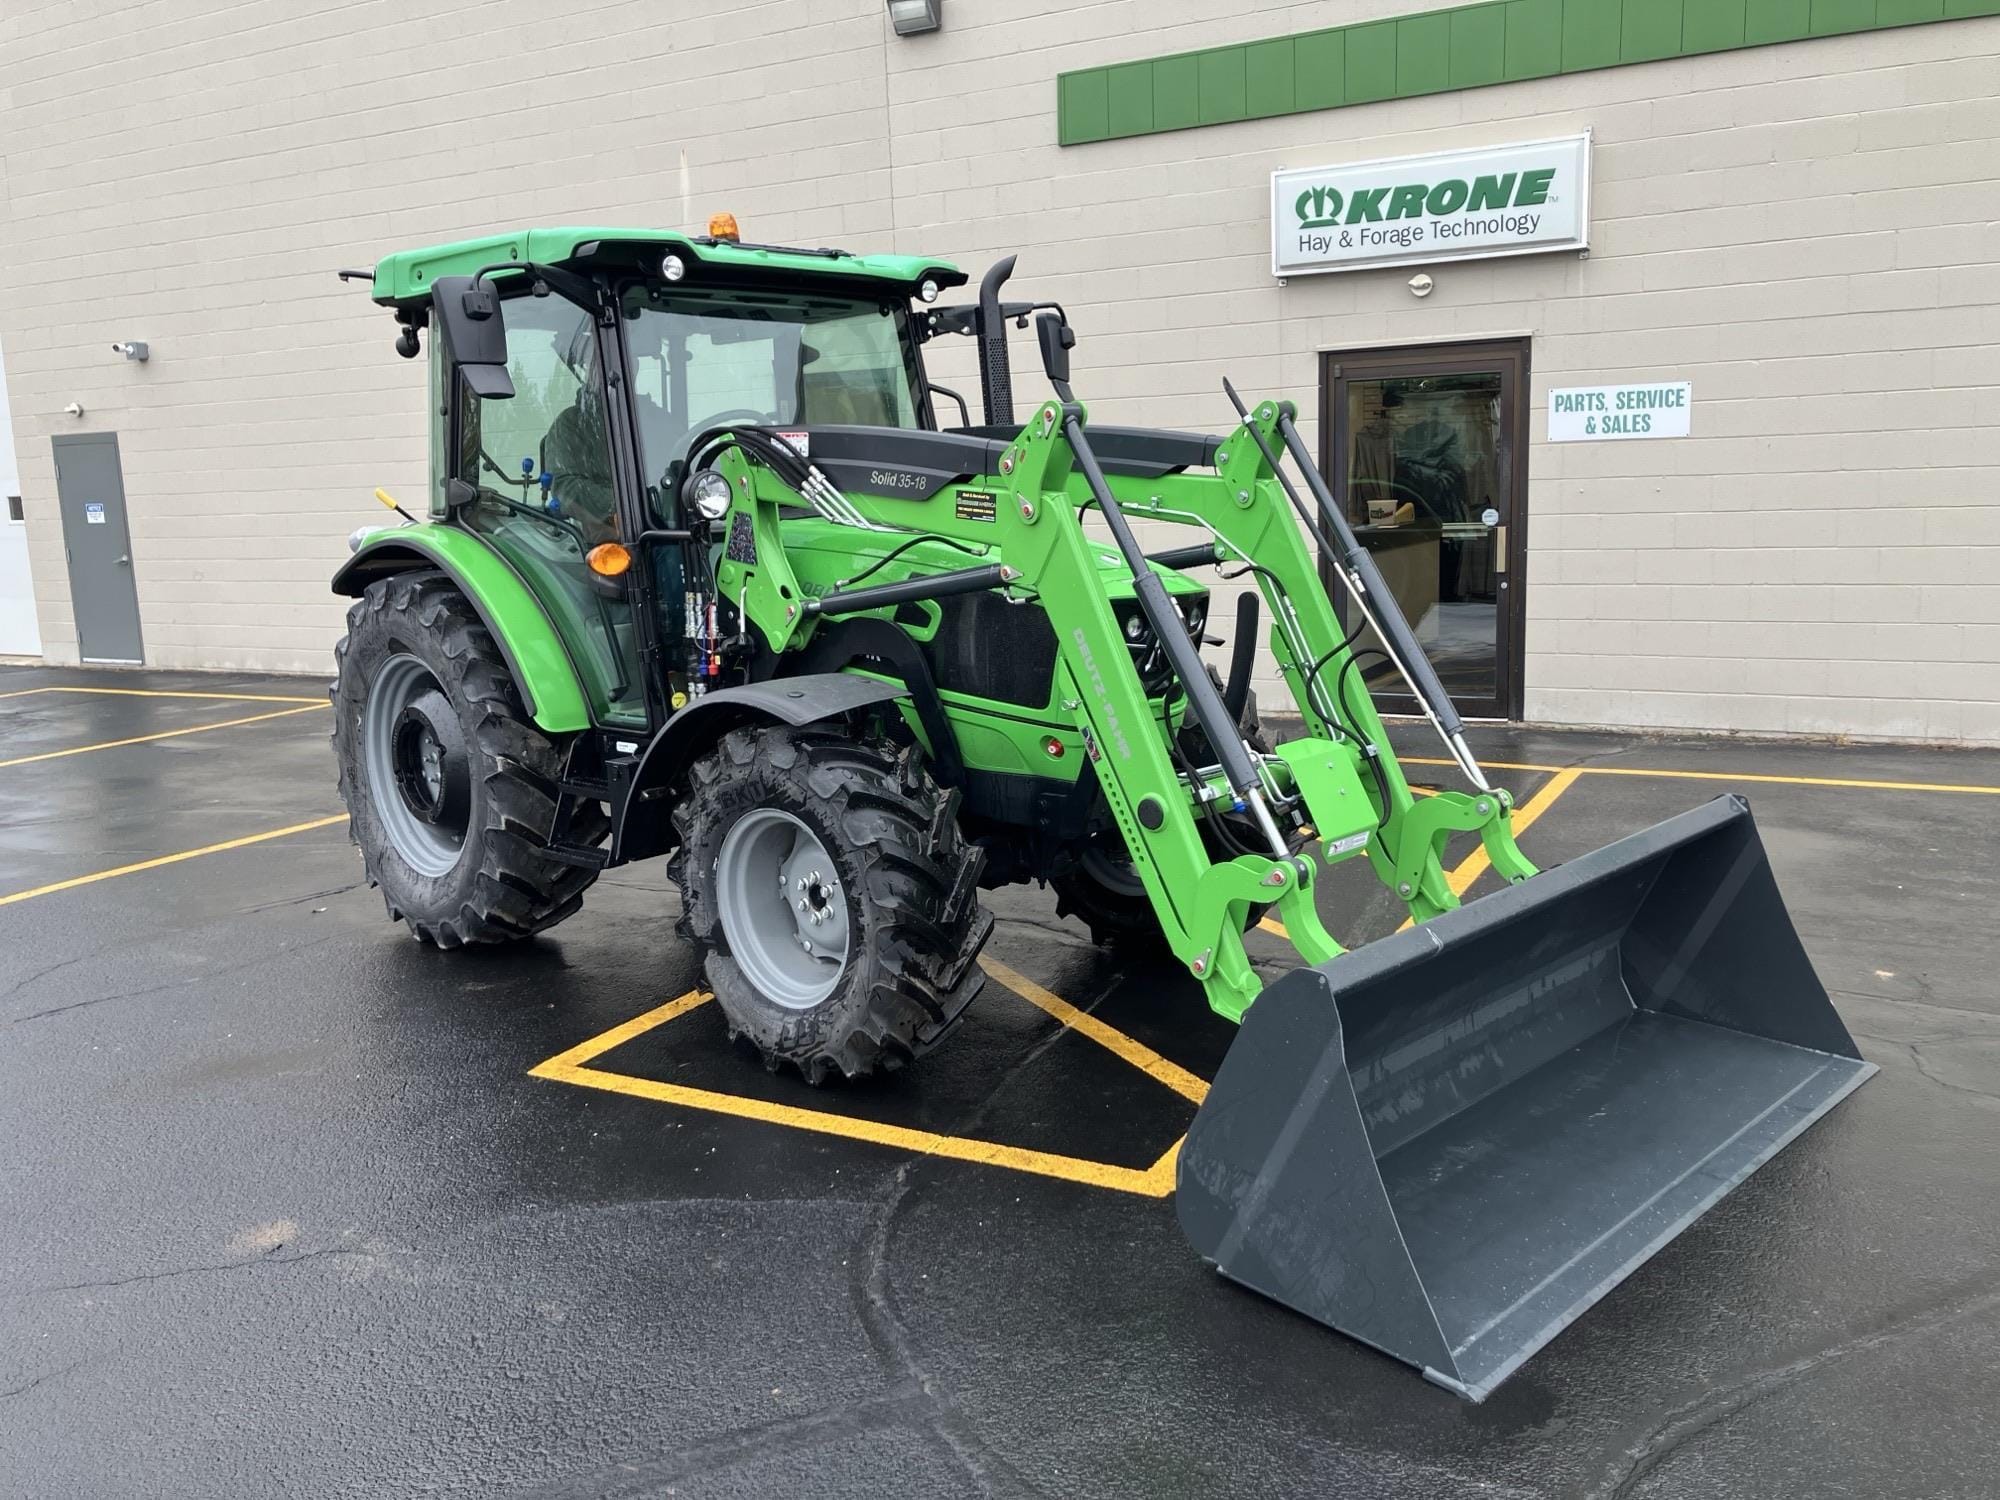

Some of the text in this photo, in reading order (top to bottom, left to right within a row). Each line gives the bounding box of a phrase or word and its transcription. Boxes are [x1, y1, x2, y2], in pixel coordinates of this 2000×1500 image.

[1345, 168, 1556, 224] KRONE
[1299, 214, 1541, 254] Hay & Forage Technology
[1554, 388, 1685, 413] PARTS, SERVICE
[1585, 413, 1651, 434] & SALES
[870, 470, 927, 490] Solid 35-18
